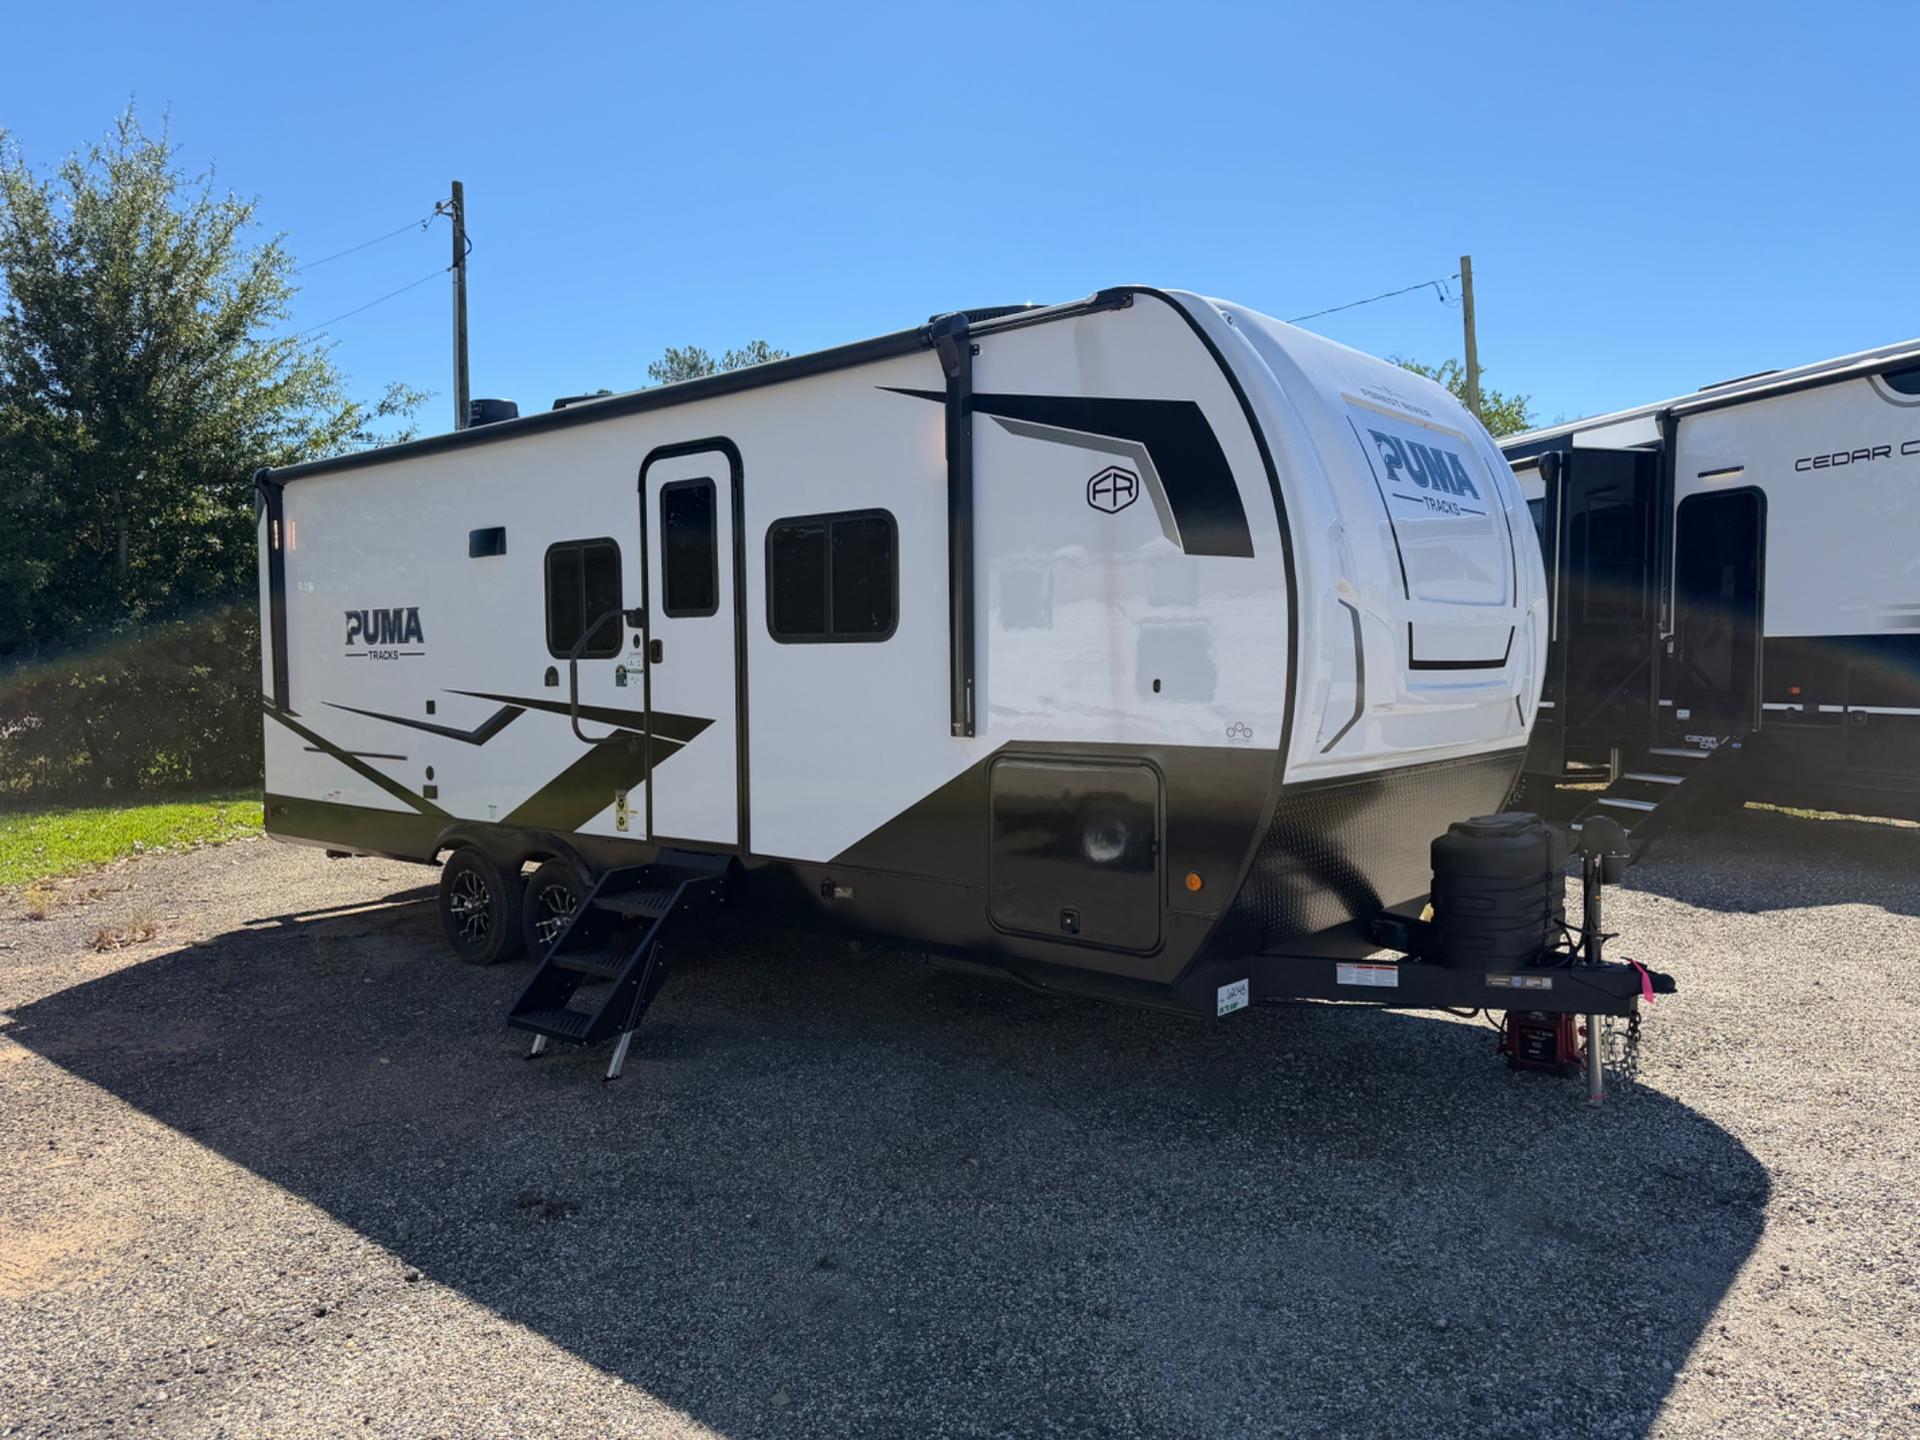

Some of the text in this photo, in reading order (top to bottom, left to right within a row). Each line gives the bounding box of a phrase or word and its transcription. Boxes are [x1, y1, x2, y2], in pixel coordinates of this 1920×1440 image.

[1367, 428, 1481, 500] PUMA
[1795, 445, 1892, 472] CEDAR
[1423, 496, 1461, 516] TRACKS
[344, 606, 424, 645] PUMA
[368, 650, 399, 661] TRACKS
